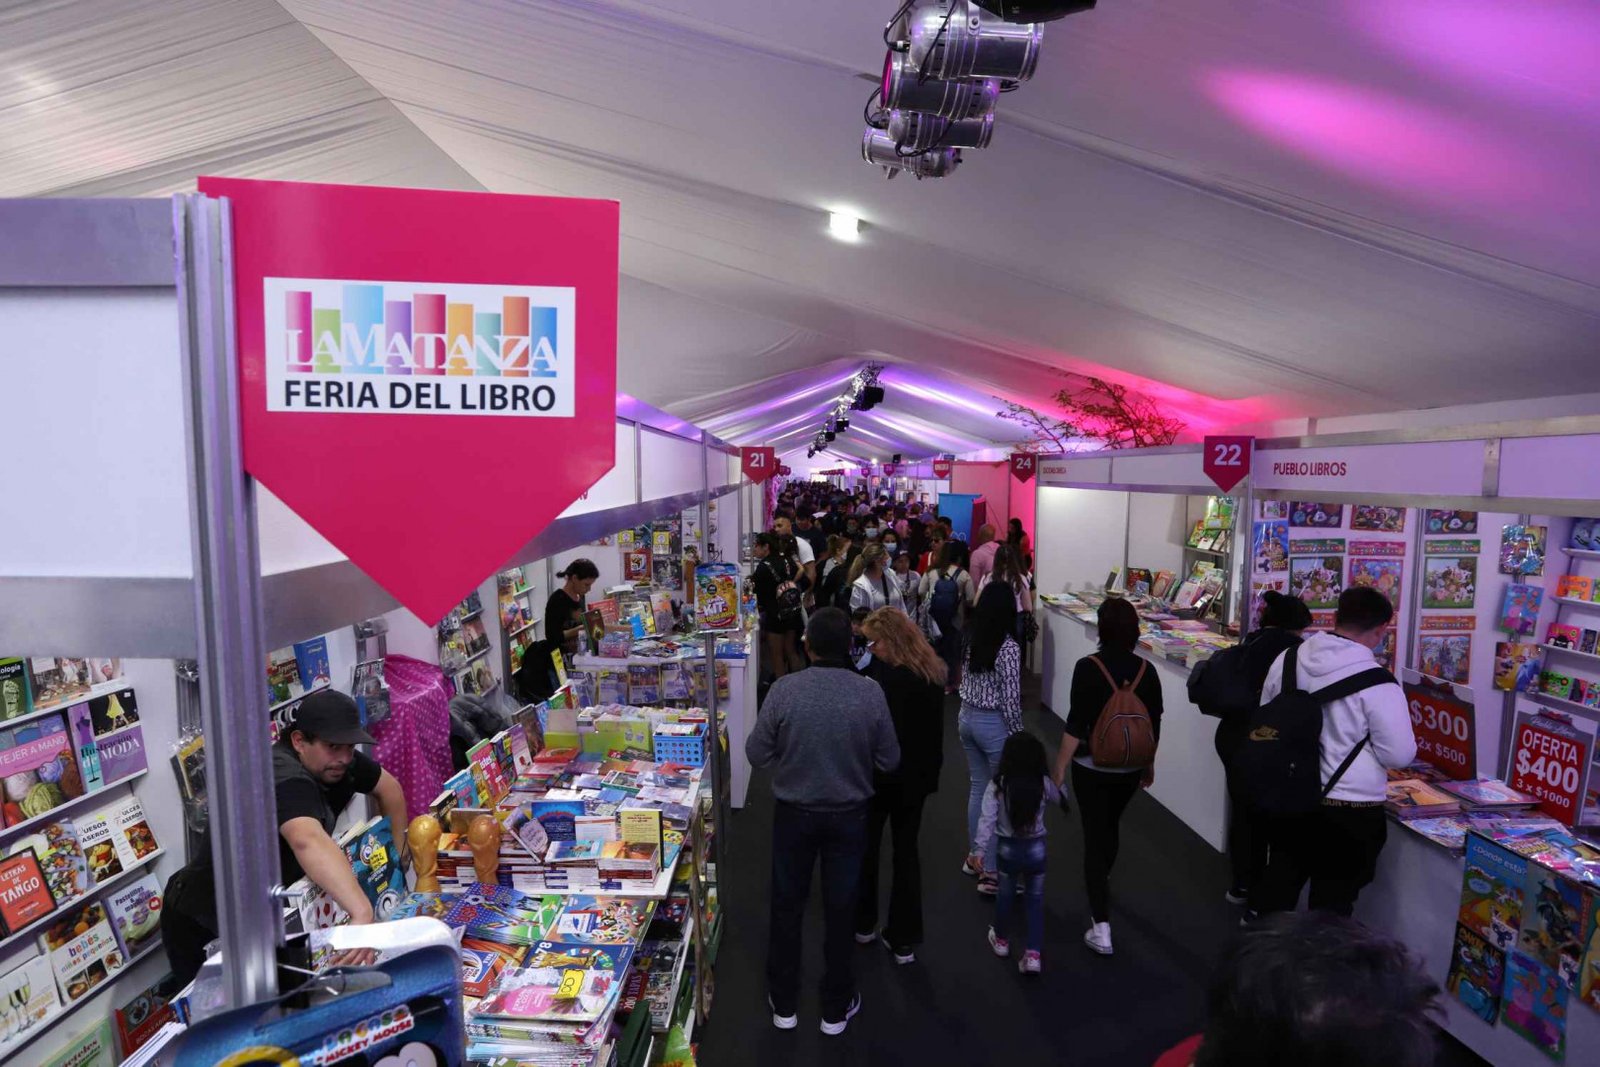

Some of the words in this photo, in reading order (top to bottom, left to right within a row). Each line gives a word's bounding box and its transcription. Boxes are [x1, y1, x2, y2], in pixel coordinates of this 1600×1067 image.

[284, 379, 379, 409] FERIA
[389, 381, 451, 410] DEL
[460, 383, 556, 412] LIBRO
[749, 452, 765, 468] 21
[1015, 457, 1032, 469] 24
[1214, 443, 1242, 466] 22
[1273, 462, 1309, 476] PUEBLO
[1310, 462, 1347, 477] LIBROS
[1409, 699, 1469, 742] $300
[38, 735, 66, 752] MANO
[101, 738, 140, 761] MODA
[1435, 742, 1466, 766] $500
[1522, 729, 1578, 766] OFERTA
[1516, 748, 1579, 794] $400
[1516, 778, 1523, 789] 3
[1535, 787, 1570, 808] $1000
[1, 864, 27, 882] LETRAS
[1, 876, 40, 904] TANGO
[326, 1039, 369, 1063] MICKEY
[373, 1019, 412, 1042] MOUSE
